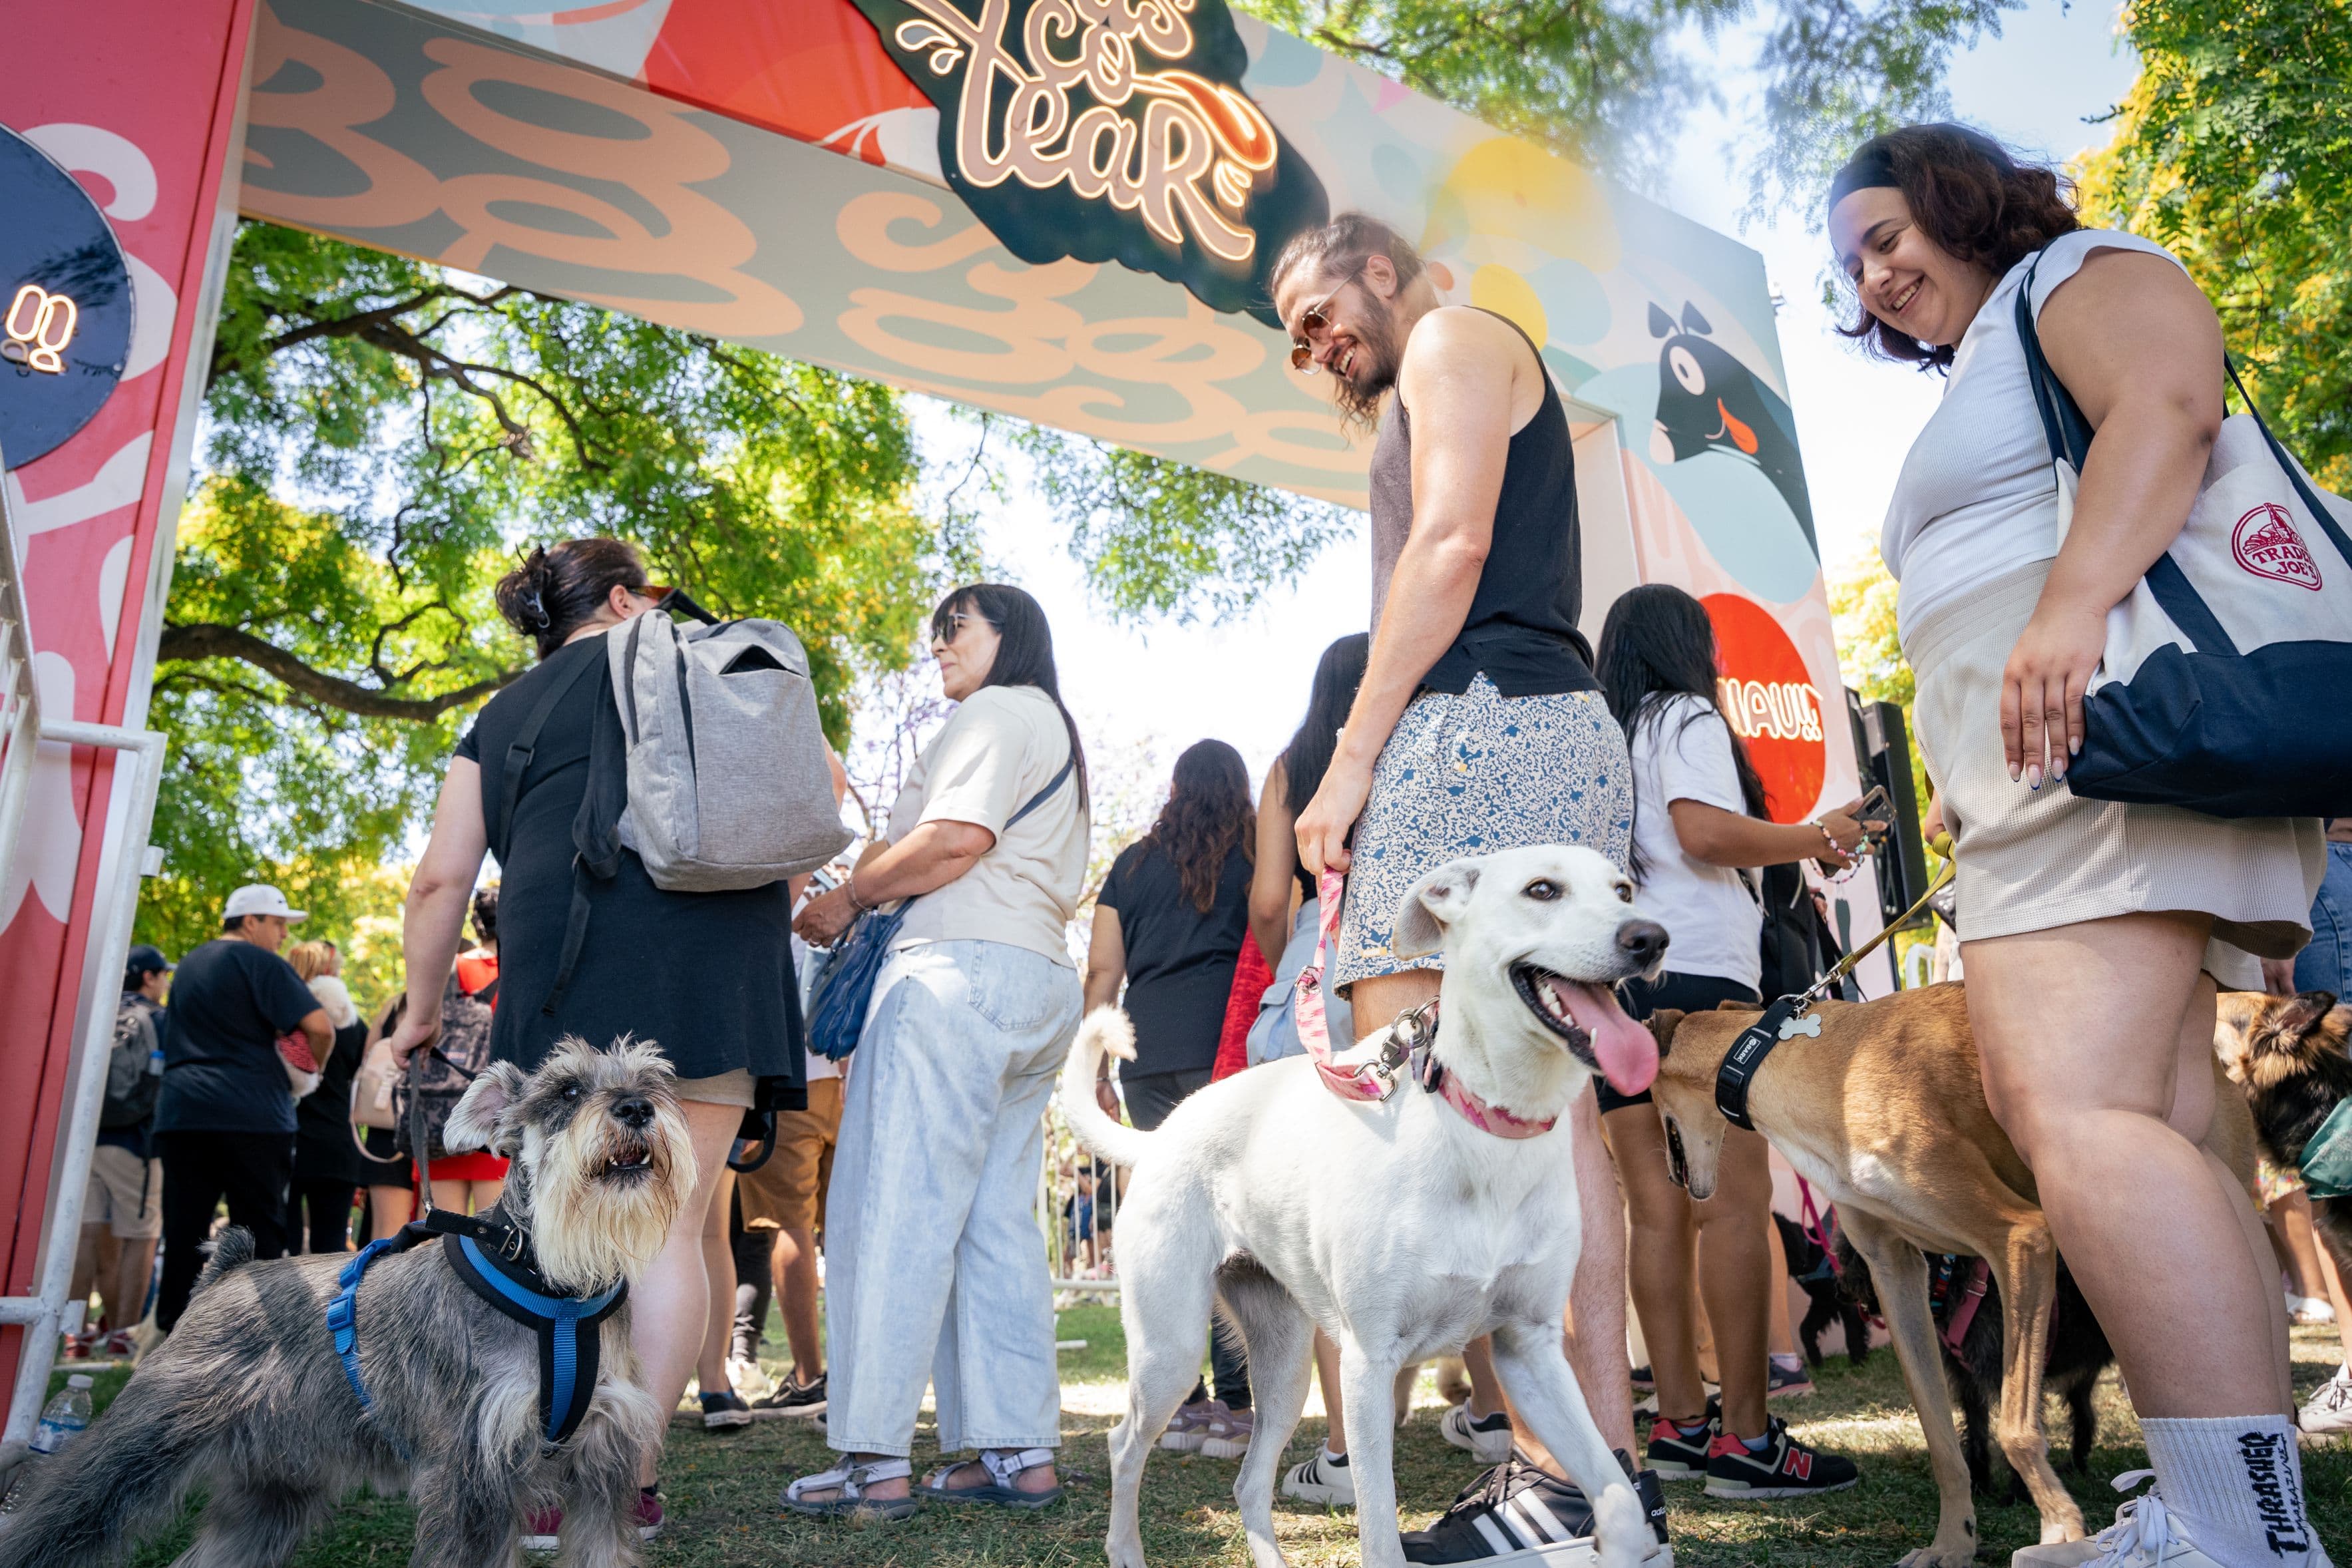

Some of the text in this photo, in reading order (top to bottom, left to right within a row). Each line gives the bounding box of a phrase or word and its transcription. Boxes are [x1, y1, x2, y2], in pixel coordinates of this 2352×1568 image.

[2275, 561, 2317, 580] JOE'S
[1782, 1446, 1812, 1481] N
[2238, 1432, 2308, 1559] THRASHER
